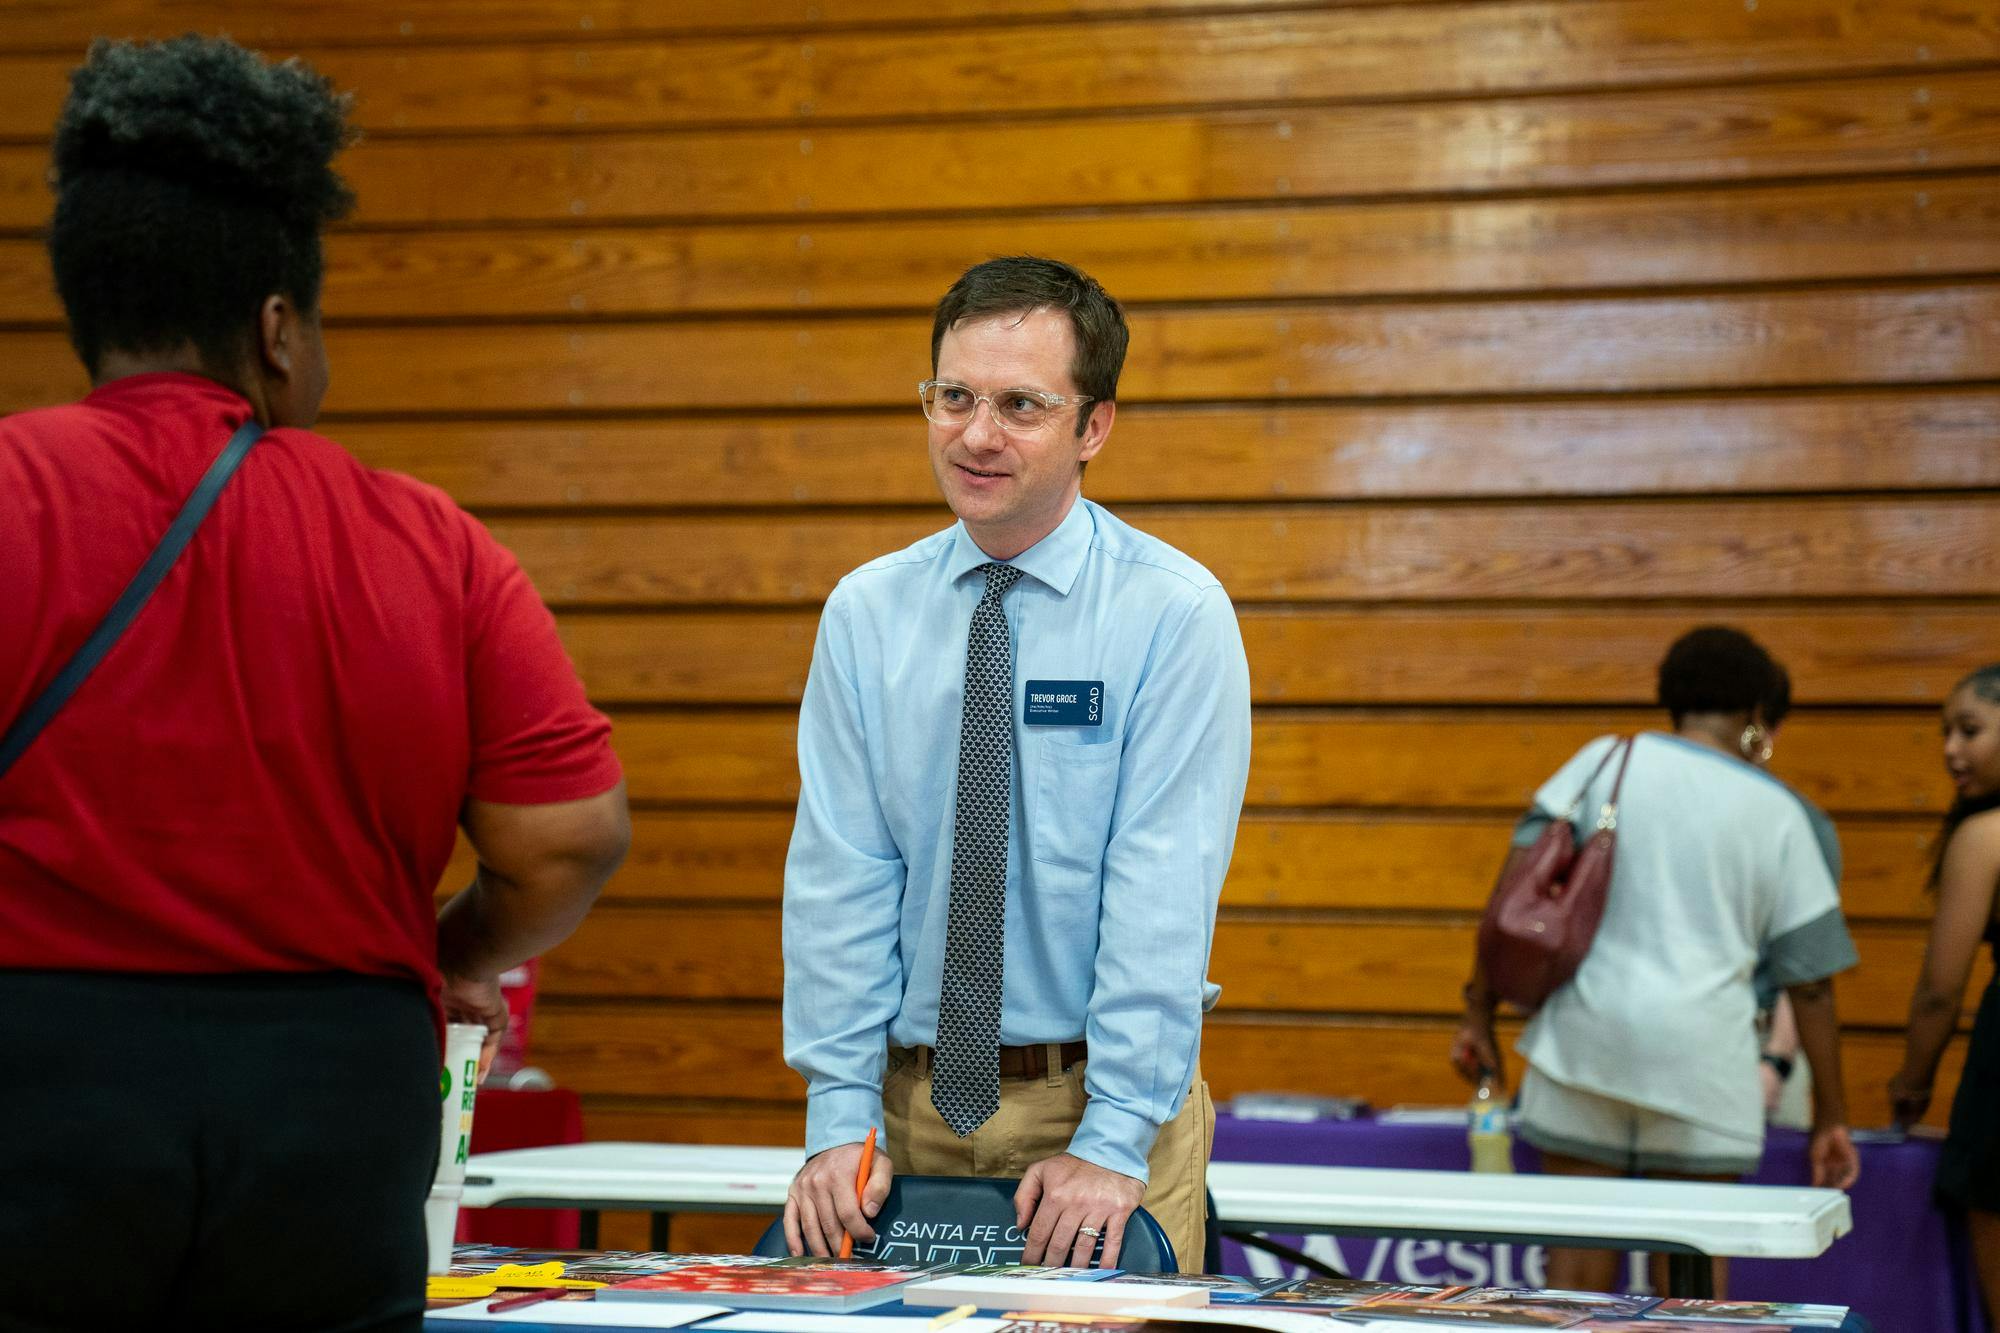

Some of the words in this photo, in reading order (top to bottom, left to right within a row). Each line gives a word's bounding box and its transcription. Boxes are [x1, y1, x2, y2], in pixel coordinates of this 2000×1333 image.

[1031, 694, 1055, 703] TREVOR
[1056, 694, 1077, 703] GROCE
[1089, 687, 1099, 721] SCAD
[889, 1220, 965, 1241] SANTA
[970, 1225, 1000, 1242] FE
